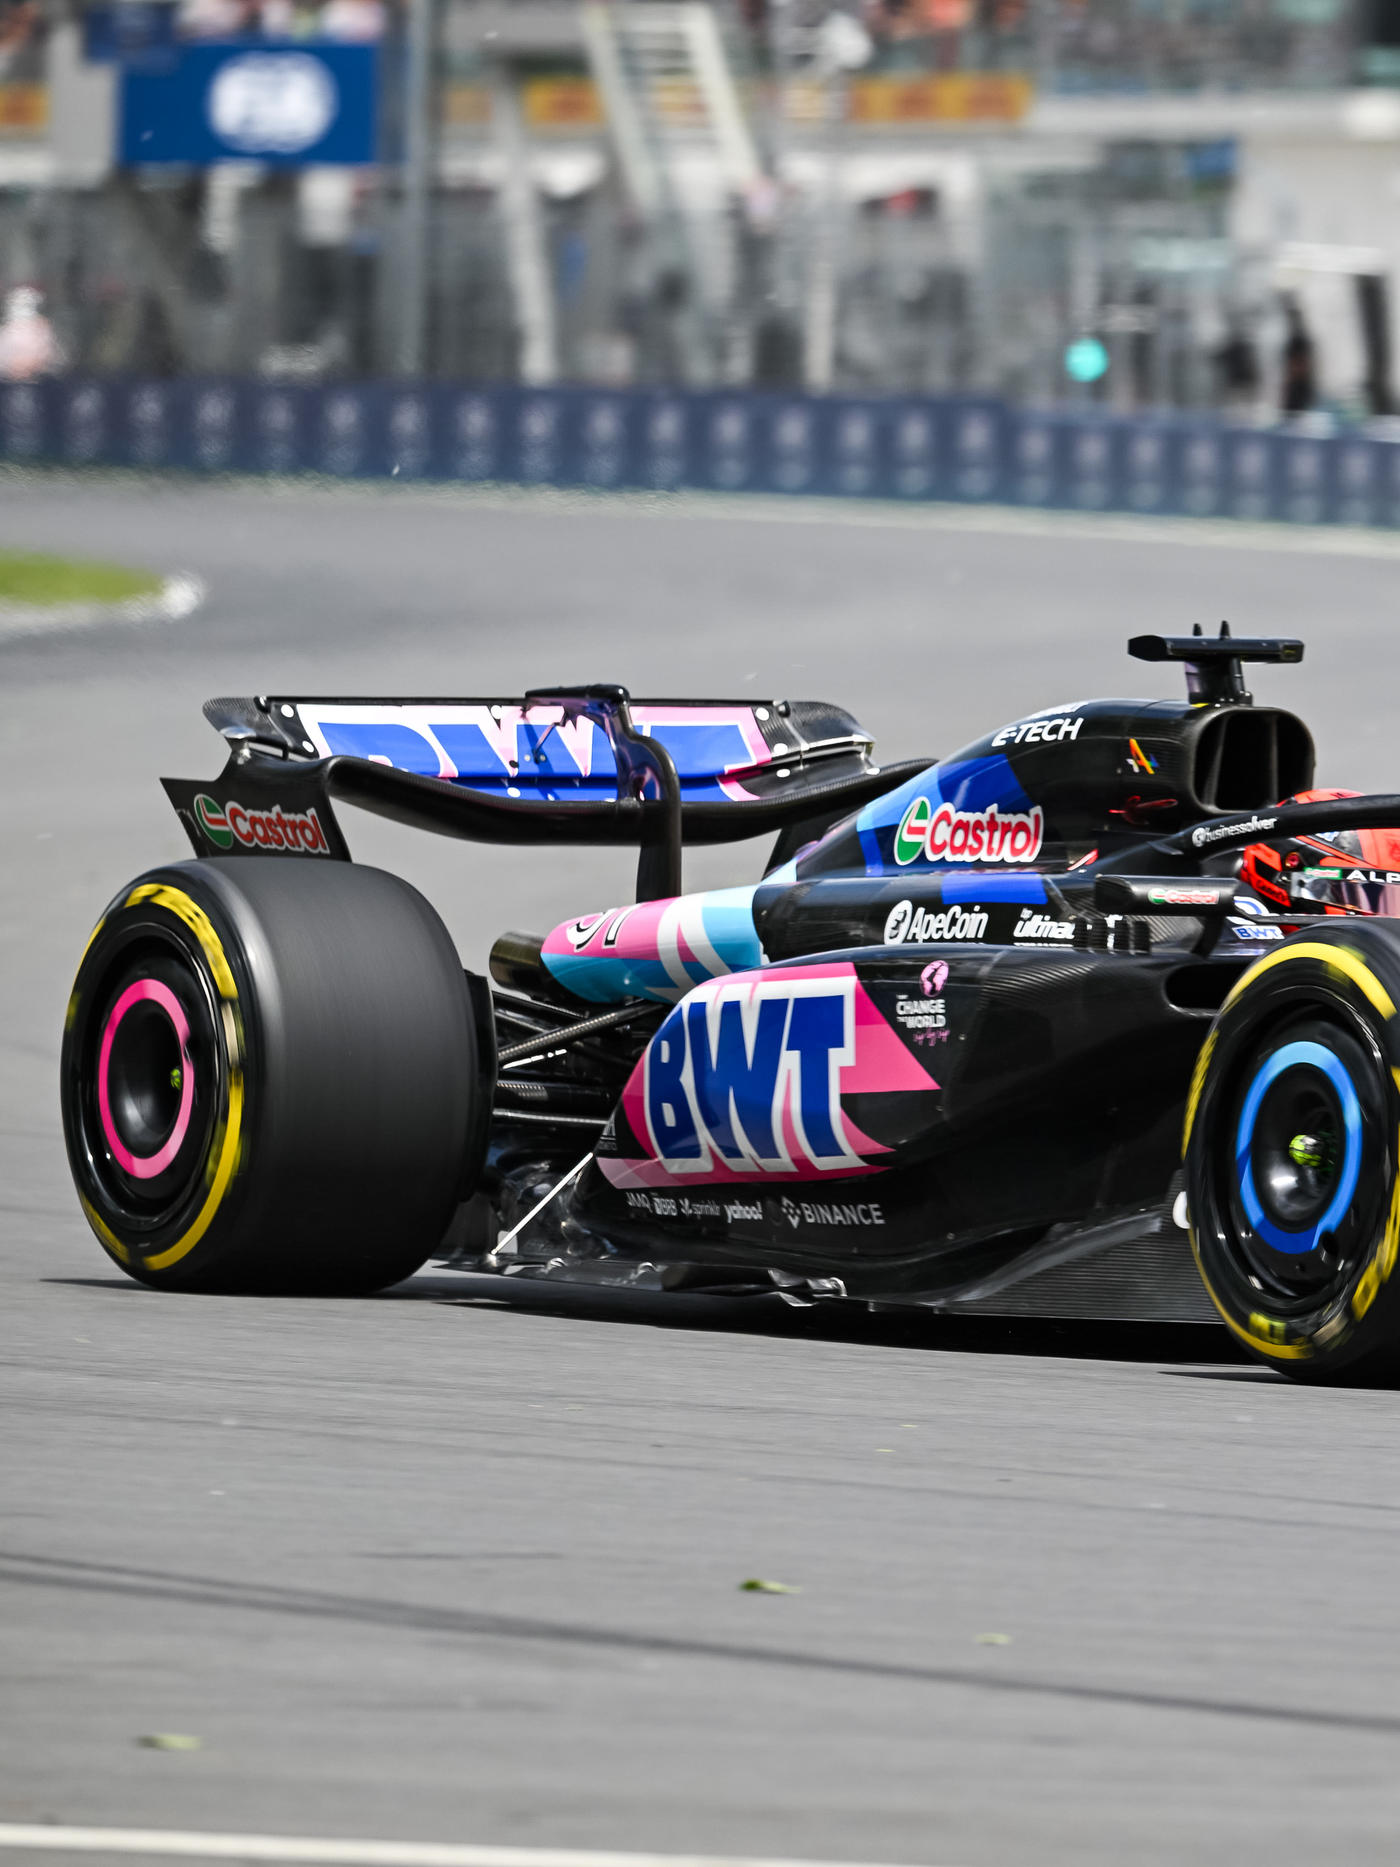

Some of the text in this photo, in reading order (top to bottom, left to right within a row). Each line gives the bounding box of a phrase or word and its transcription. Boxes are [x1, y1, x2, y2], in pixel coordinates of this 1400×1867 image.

[991, 717, 1084, 747] E-TECH
[226, 802, 330, 854] Castrol
[926, 804, 1043, 862] Castrol
[906, 905, 989, 944] ApeCoin
[1233, 926, 1284, 939] BWT
[896, 999, 946, 1015] CHANGE
[906, 1014, 946, 1028] WORLD
[645, 982, 863, 1170] BWT
[724, 1200, 763, 1223] yahoo!
[800, 1202, 885, 1225] BINANCE
